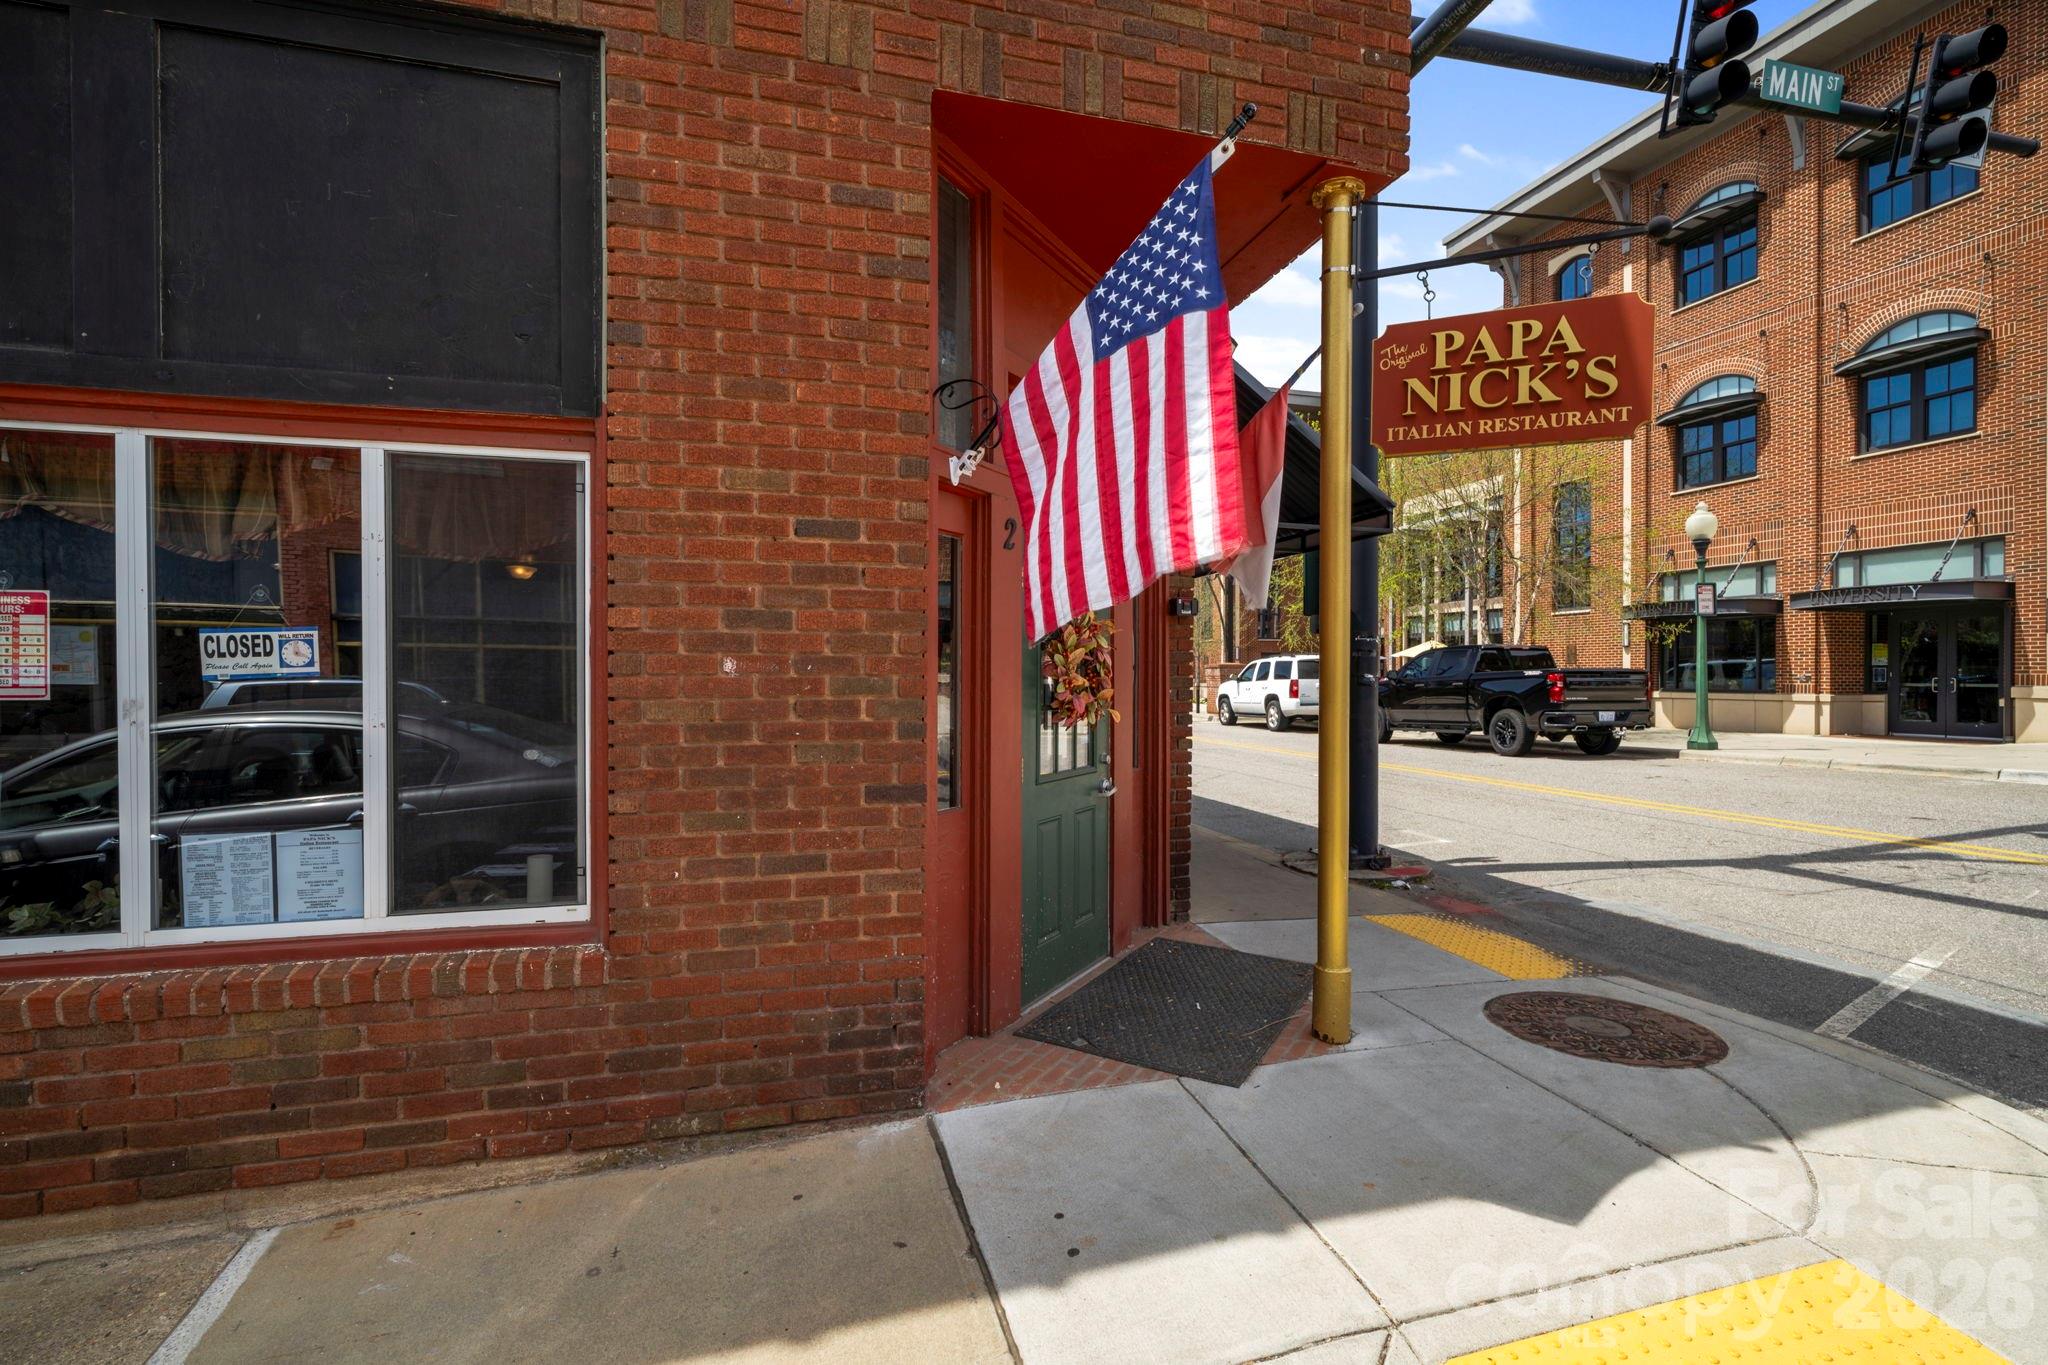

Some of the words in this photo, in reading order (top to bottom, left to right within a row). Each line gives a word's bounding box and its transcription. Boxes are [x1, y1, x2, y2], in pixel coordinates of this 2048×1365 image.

[1769, 65, 1824, 106] MAIN
[1827, 75, 1840, 91] ST
[1380, 344, 1408, 360] The
[1380, 343, 1428, 371] Original
[1430, 314, 1586, 370] PAPA
[1402, 354, 1619, 416] NICK'S
[1386, 421, 1473, 442] ITALIAN
[1477, 406, 1633, 434] RESTAURANT
[1003, 518, 1017, 551] 2
[1808, 584, 1923, 606] UNIVERSITY
[203, 634, 274, 659] CLOSED
[205, 663, 230, 671] Please
[231, 662, 248, 671] Call
[250, 662, 273, 671] Again
